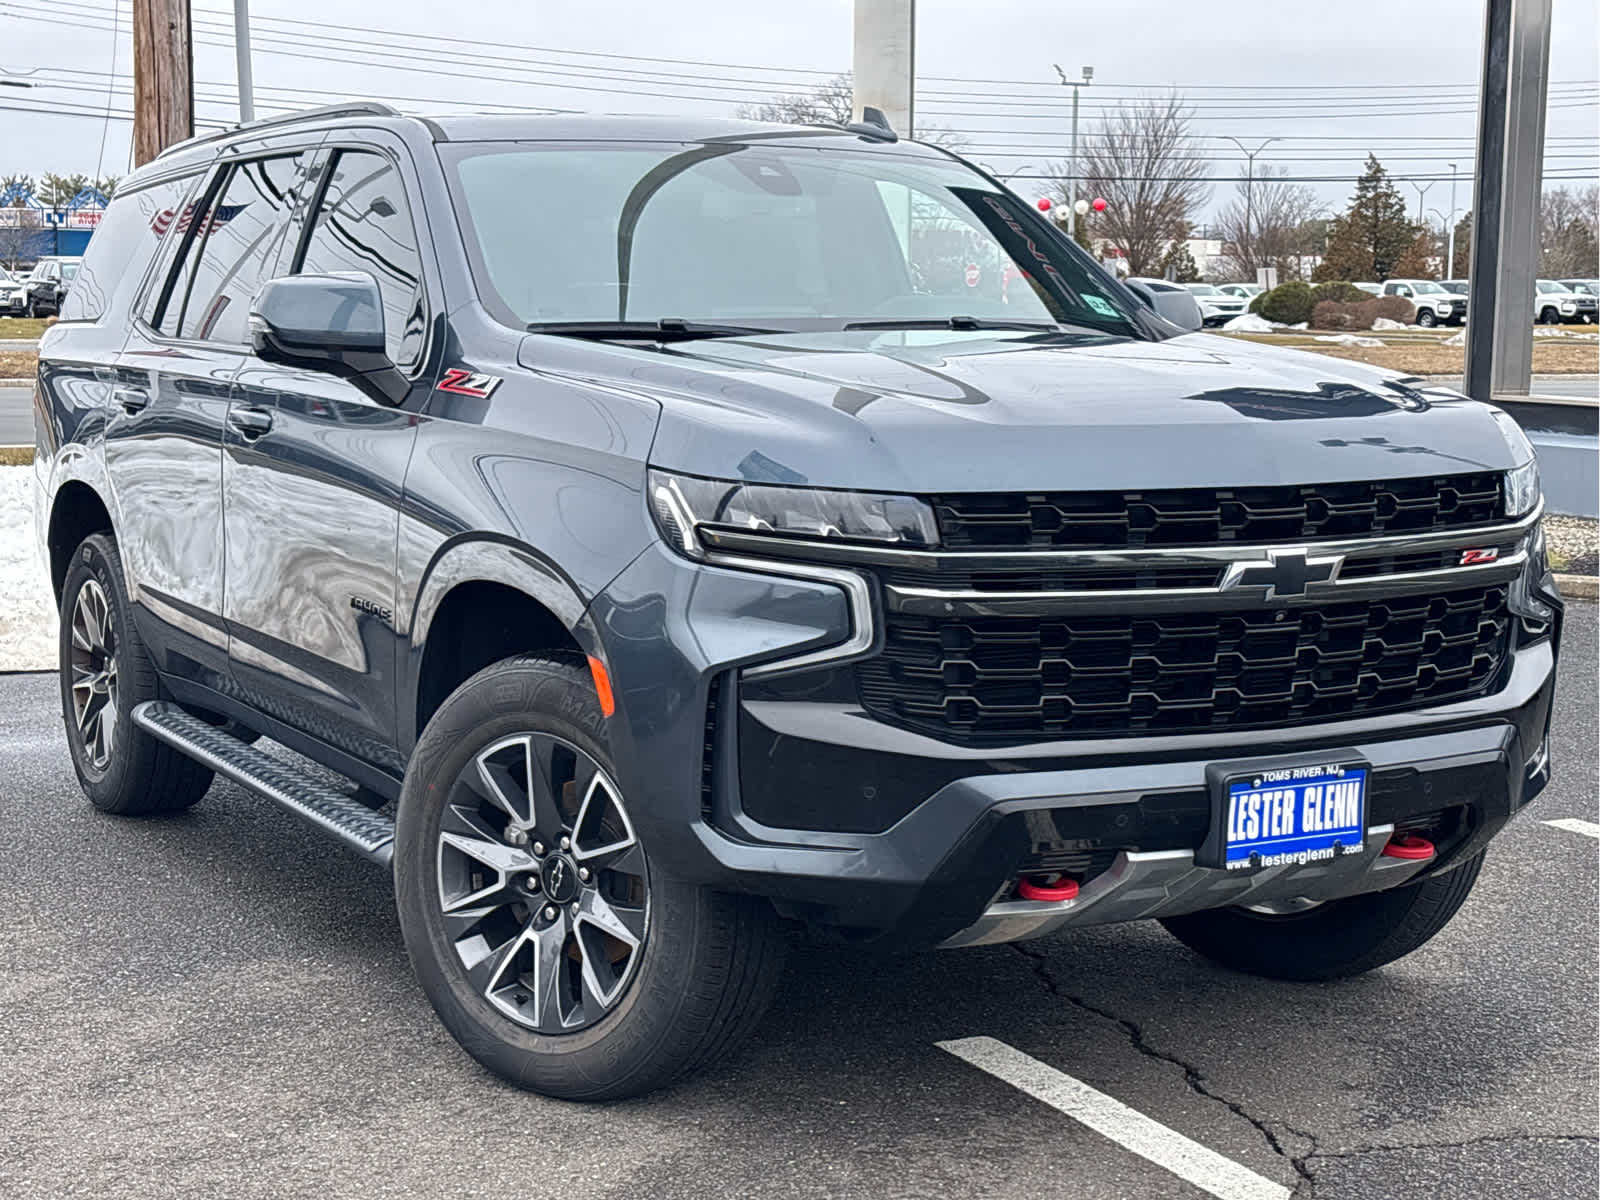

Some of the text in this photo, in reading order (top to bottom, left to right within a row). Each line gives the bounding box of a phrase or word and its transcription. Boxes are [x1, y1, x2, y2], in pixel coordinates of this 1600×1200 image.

[435, 368, 504, 399] Z71
[1459, 547, 1499, 565] Z71
[1263, 770, 1291, 782] TOMS
[1326, 765, 1340, 775] NJ
[1227, 782, 1360, 842] LESTER GLENN
